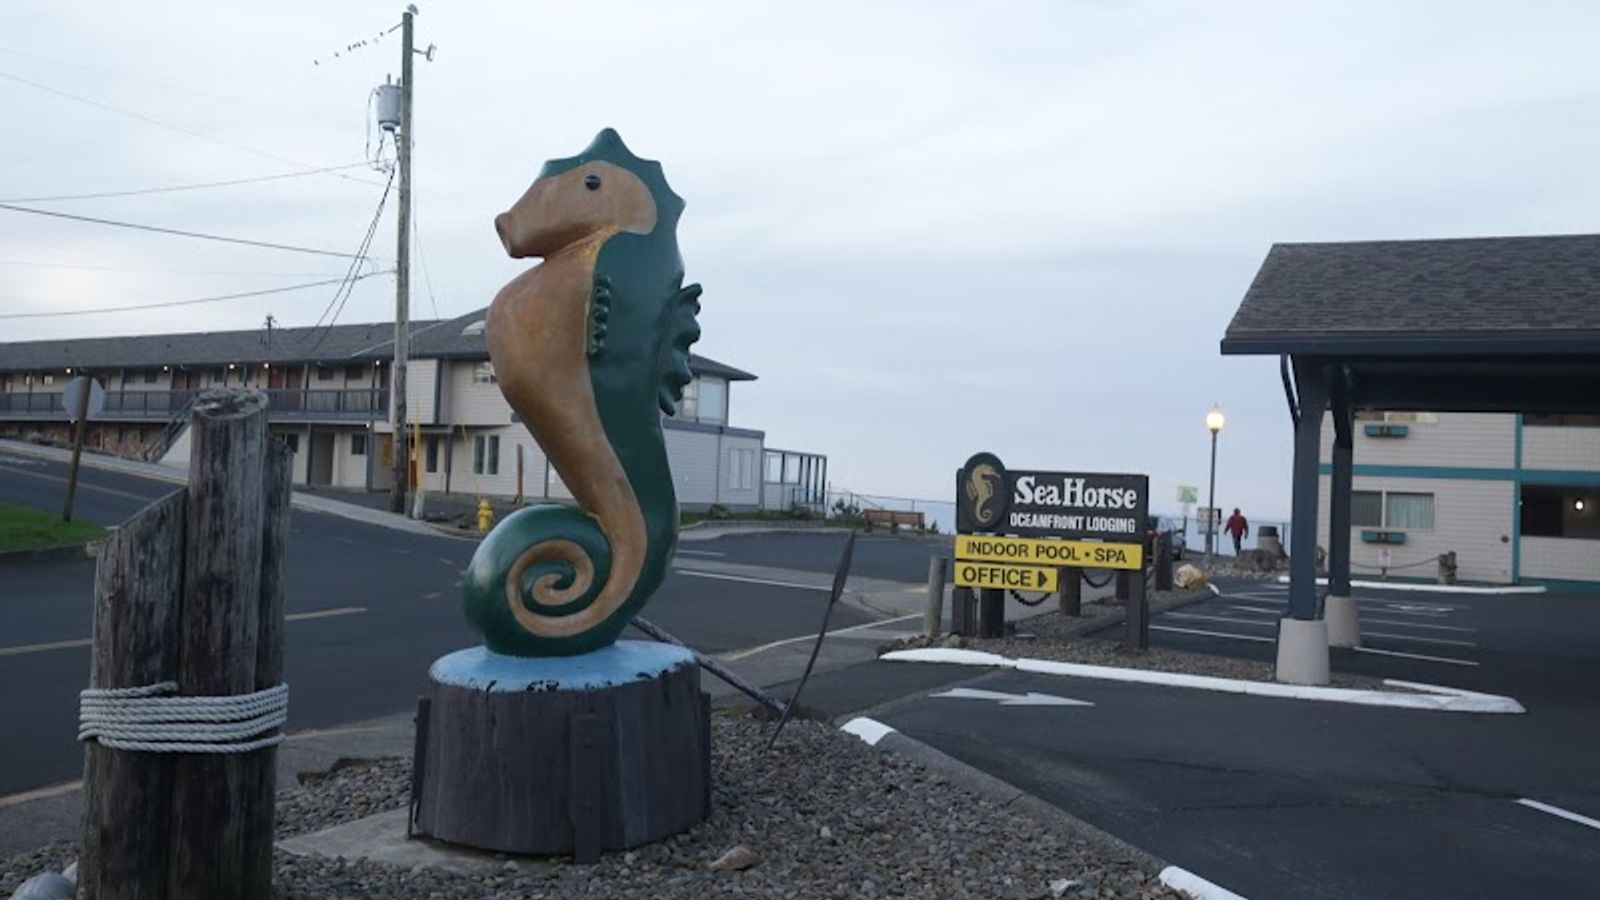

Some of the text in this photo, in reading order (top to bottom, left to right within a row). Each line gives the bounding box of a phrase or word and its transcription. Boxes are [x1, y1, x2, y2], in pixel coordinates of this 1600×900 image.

[1010, 512, 1136, 533] OCEANFRONT LODGING
[967, 541, 1127, 563] INDOOR POOL SPA
[962, 566, 1032, 587] OFFICE
